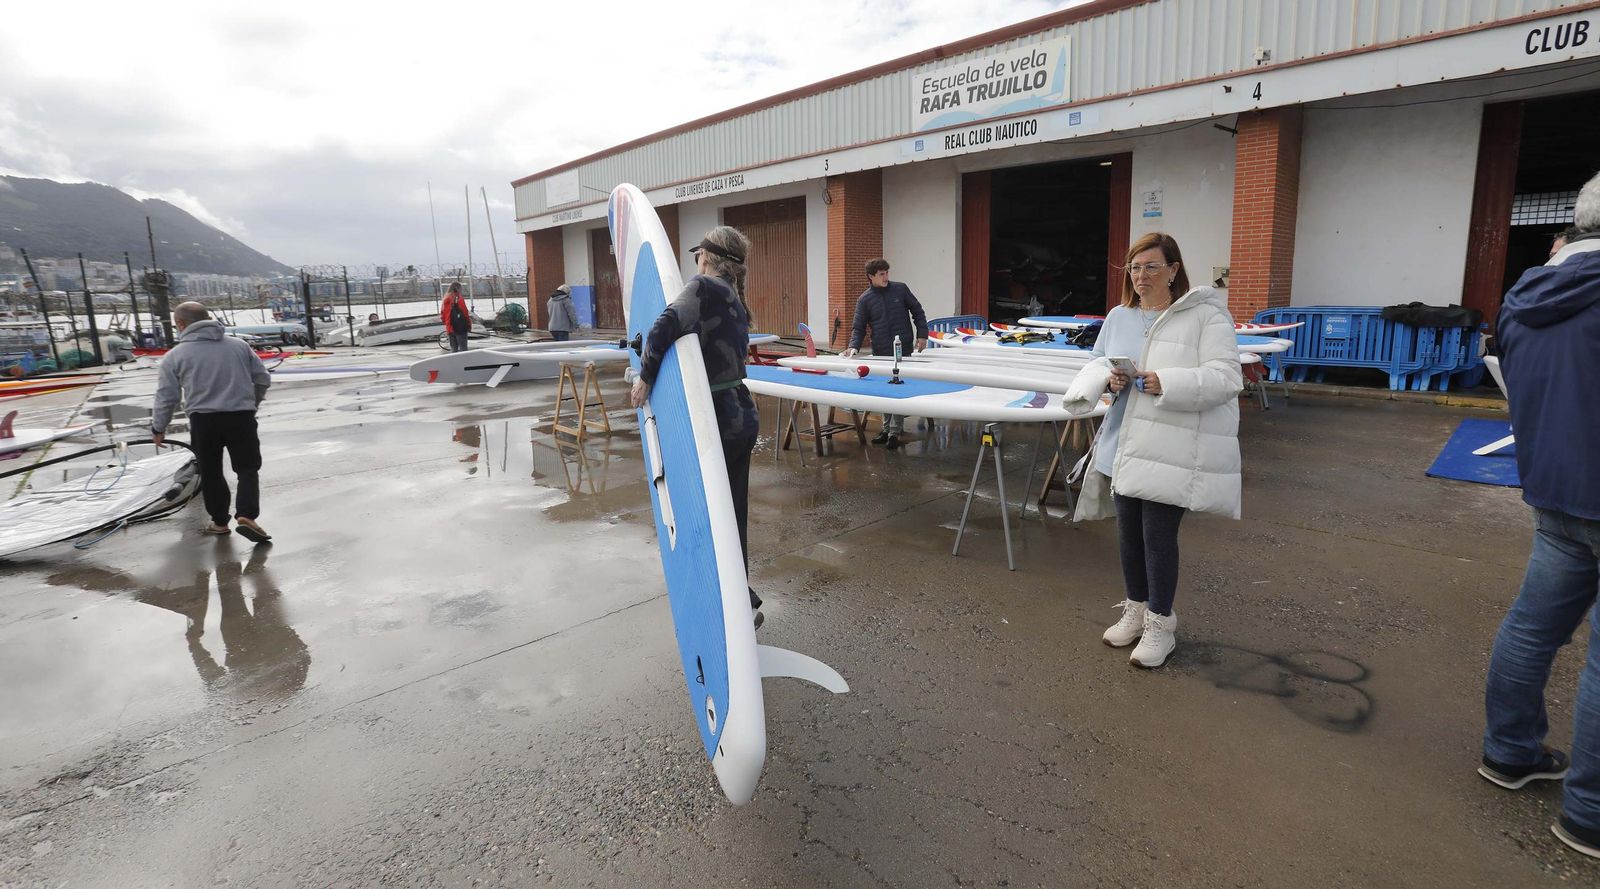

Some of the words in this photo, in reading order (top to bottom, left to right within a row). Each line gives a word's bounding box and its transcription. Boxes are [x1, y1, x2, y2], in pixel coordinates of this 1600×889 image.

[1525, 20, 1590, 55] CLUB
[922, 66, 980, 95] Escuela
[985, 60, 1005, 80] de
[1011, 49, 1048, 74] vela
[920, 89, 961, 115] RAFA
[966, 70, 1047, 104] TRUJILLO
[1252, 81, 1262, 102] 4
[944, 131, 966, 150] REAL
[969, 127, 992, 147] CLUB
[995, 119, 1038, 142] NAUTICO
[675, 187, 686, 198] CLUB
[705, 181, 711, 193] DE
[712, 178, 724, 191] CAZA
[729, 174, 745, 188] PESCA
